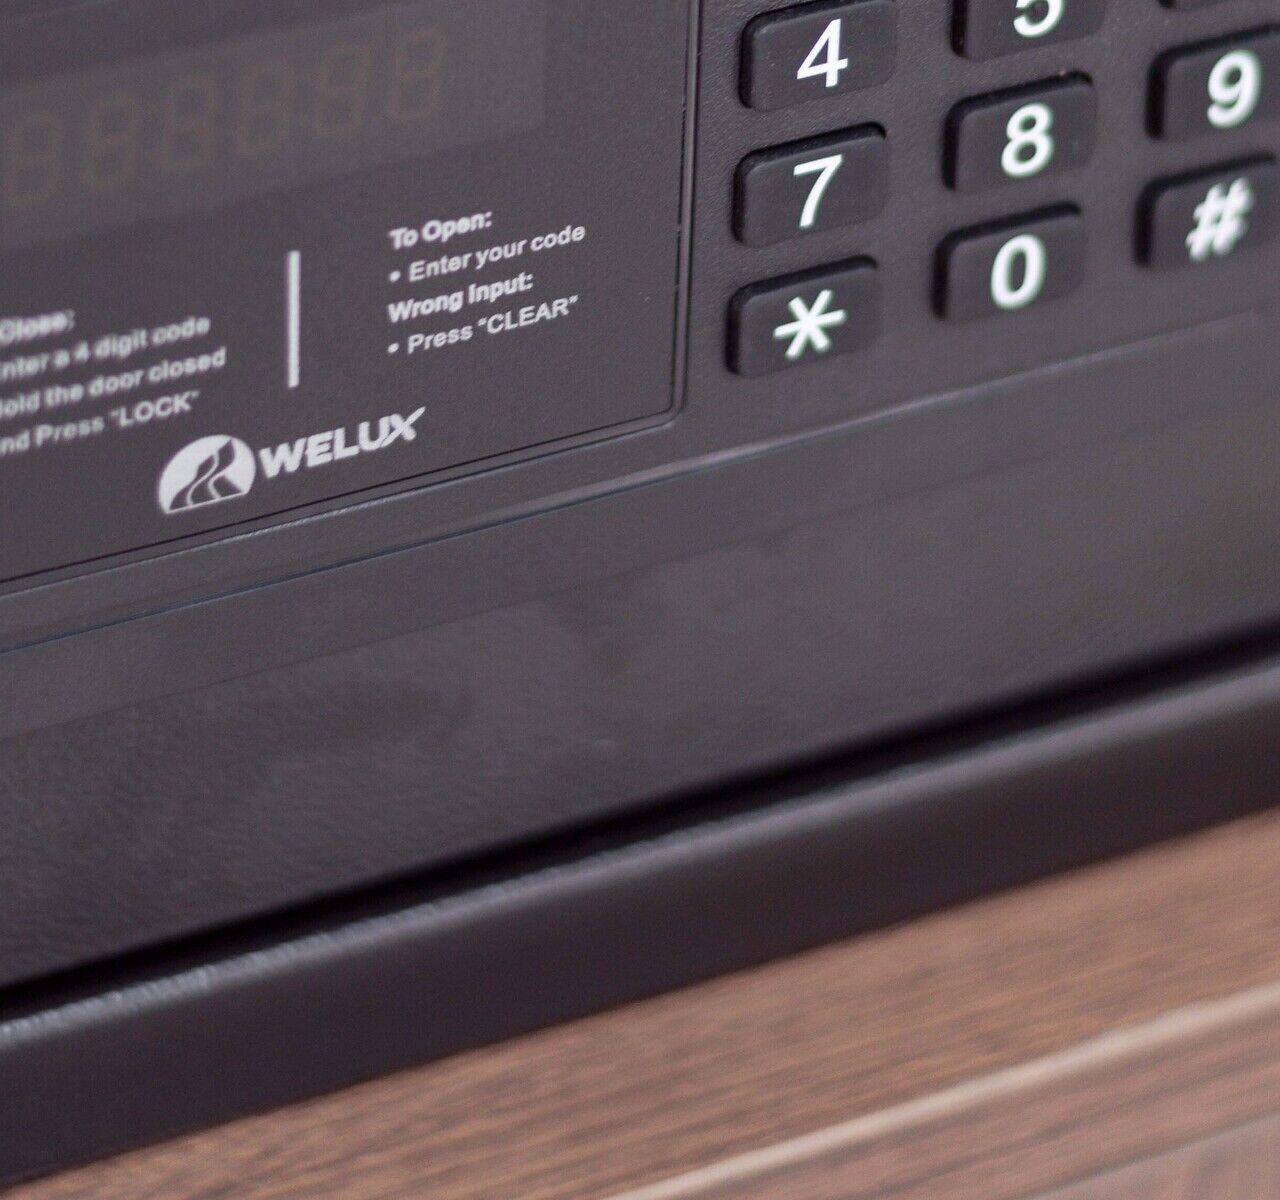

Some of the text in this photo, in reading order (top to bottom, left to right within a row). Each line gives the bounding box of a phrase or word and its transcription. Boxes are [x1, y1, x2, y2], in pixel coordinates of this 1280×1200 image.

[796, 18, 849, 88] 4
[1207, 50, 1261, 128] 9
[1001, 103, 1054, 177] 8
[793, 153, 843, 229] 7
[388, 211, 493, 250] To Open:
[408, 225, 586, 283] Enter your code
[387, 271, 534, 324] Wrong Input:
[990, 234, 1046, 309] 0
[72, 341, 91, 362] 4
[93, 329, 149, 360] digit
[150, 316, 211, 346] code
[407, 325, 474, 355] Press
[43, 383, 85, 408] the
[86, 369, 144, 398] door
[146, 346, 227, 383] closed
[33, 416, 105, 447] Press
[258, 406, 426, 479] WELUX
